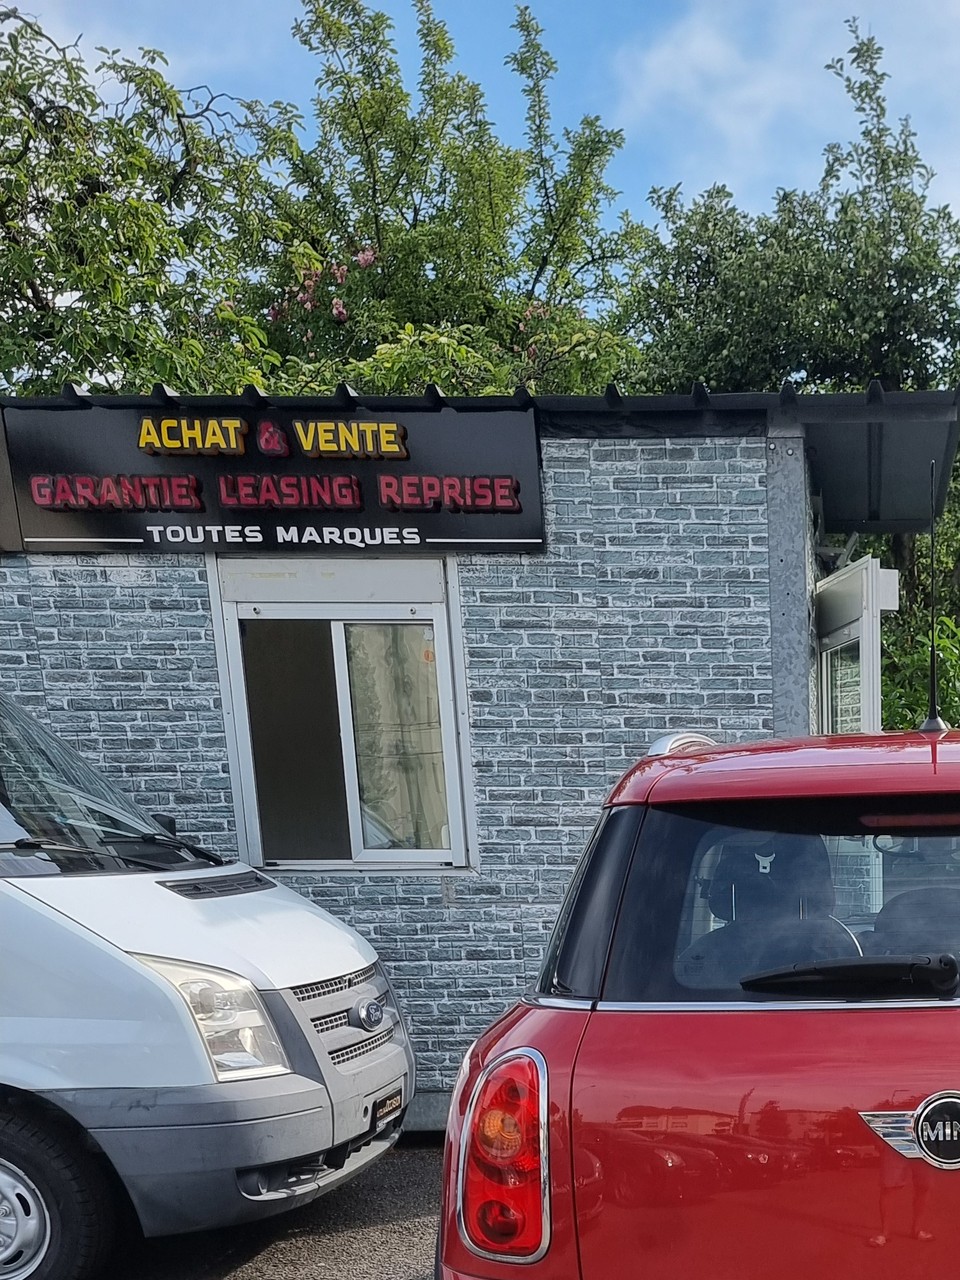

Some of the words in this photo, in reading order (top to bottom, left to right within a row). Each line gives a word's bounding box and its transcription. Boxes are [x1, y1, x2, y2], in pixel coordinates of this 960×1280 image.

[138, 418, 245, 453] ACHAT
[258, 420, 288, 454] &
[294, 419, 406, 456] VENTE
[379, 475, 519, 511] REPRISE
[146, 524, 263, 544] TOUTES
[276, 526, 421, 548] MARQUES
